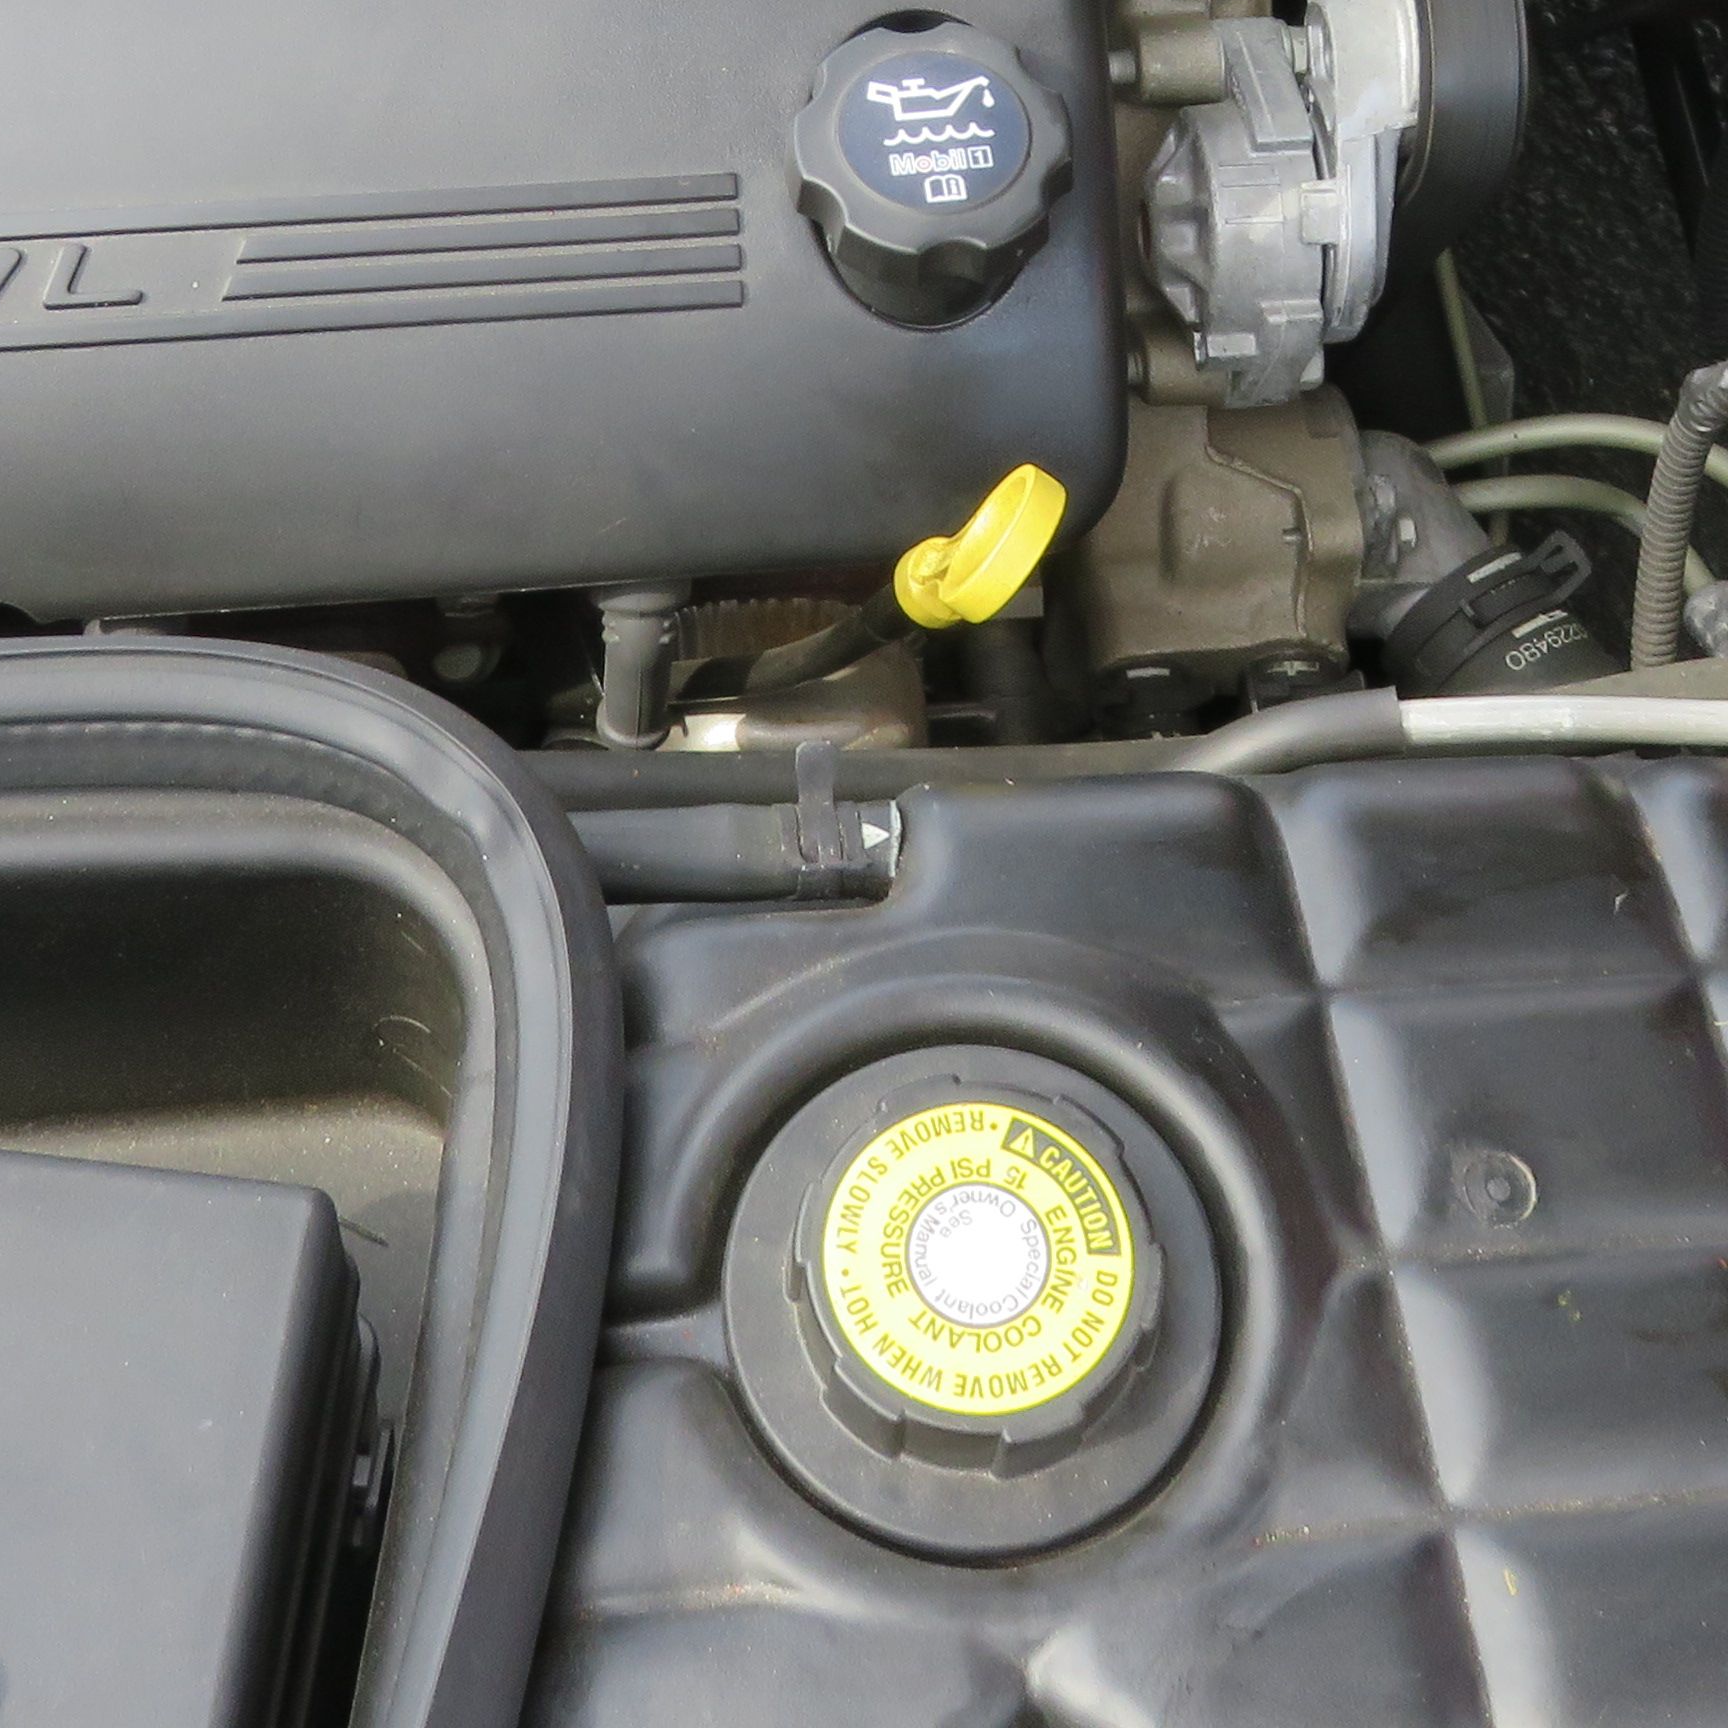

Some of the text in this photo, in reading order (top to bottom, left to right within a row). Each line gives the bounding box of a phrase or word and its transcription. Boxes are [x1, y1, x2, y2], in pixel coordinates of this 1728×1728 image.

[889, 147, 967, 176] Mobil
[836, 1110, 985, 1255] REMOVE SLOWLY
[880, 1157, 1028, 1298] 15 PSI PRESSURE
[914, 1189, 1017, 1288] Owner's Manual
[1038, 1145, 1114, 1250] CAUTION
[908, 1204, 1077, 1353] ENGINE COOLANT
[934, 1218, 1041, 1320] Special Coolant
[839, 1270, 1118, 1399] DO NOT REMOVE WHEN HOT
